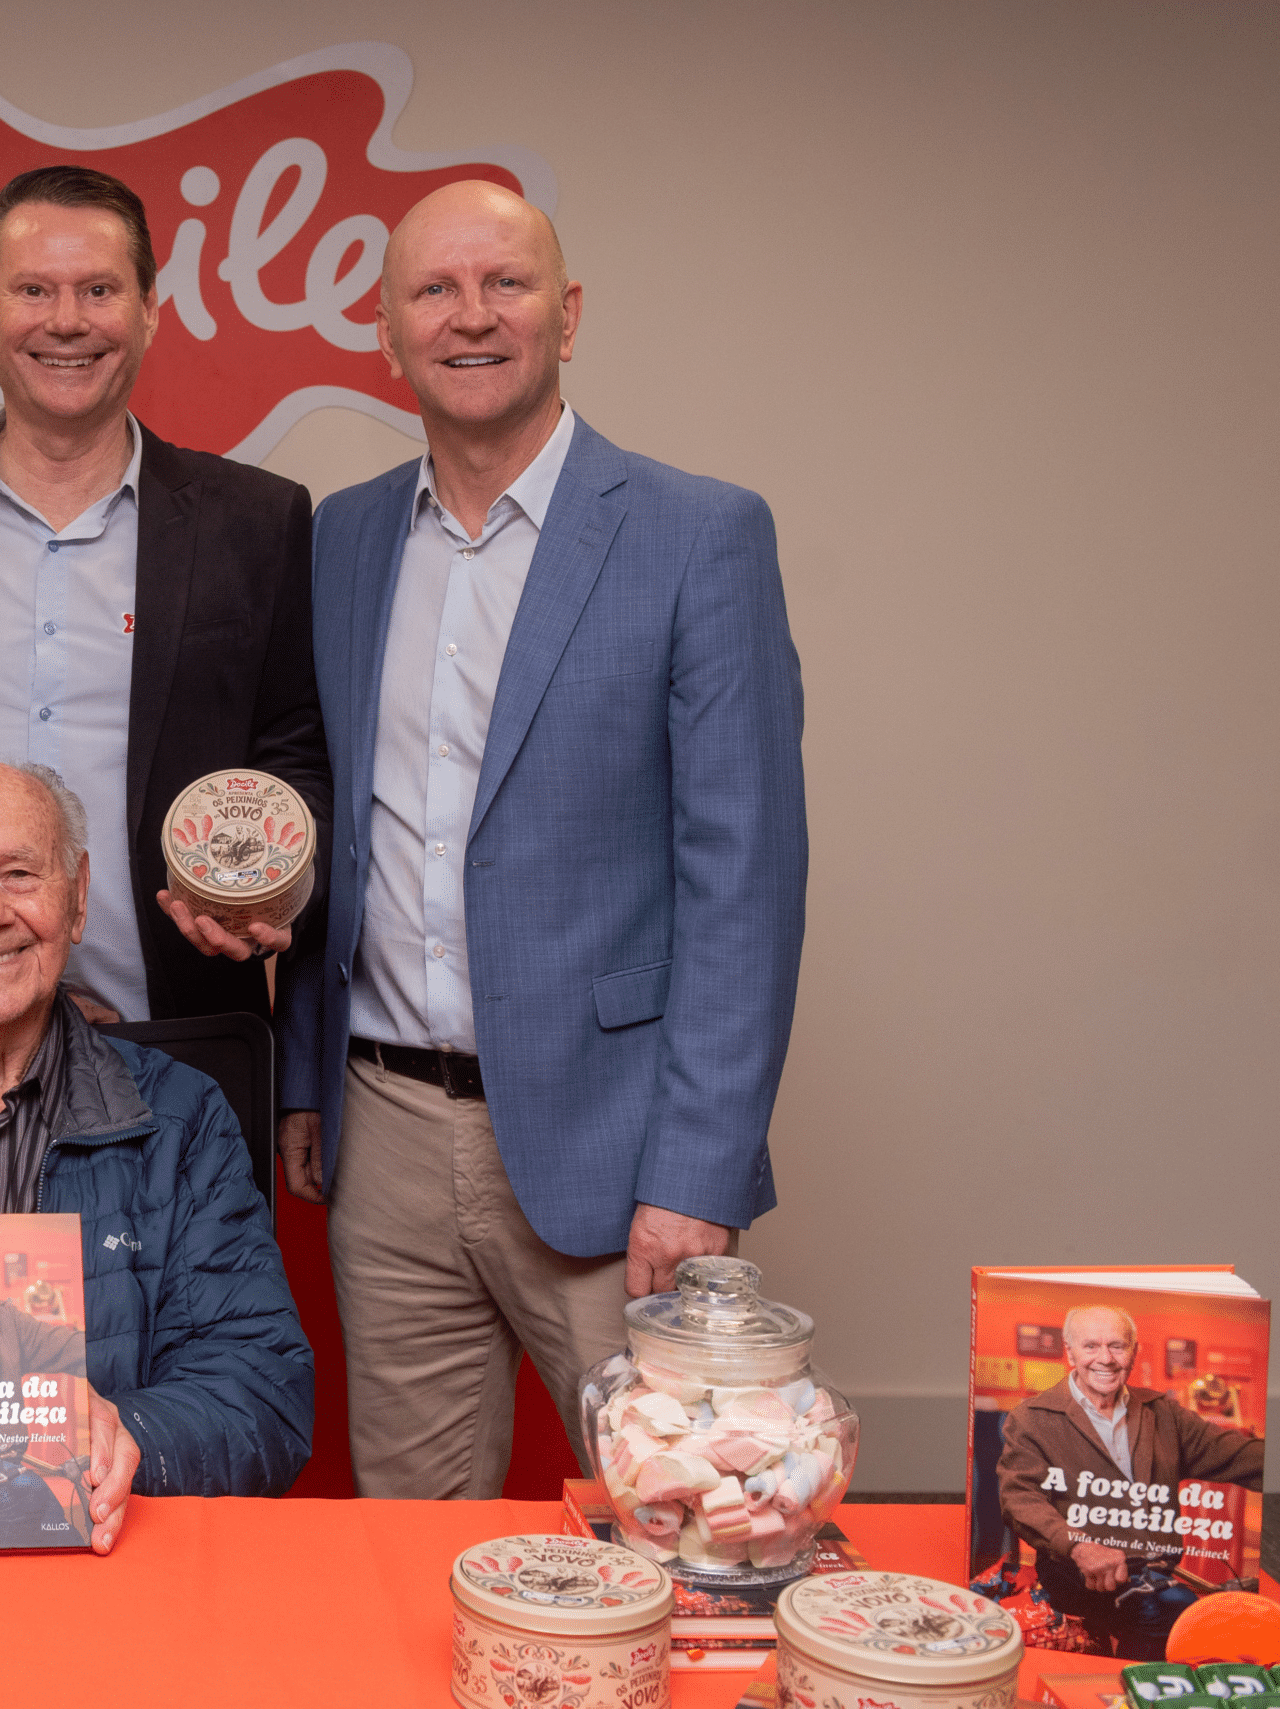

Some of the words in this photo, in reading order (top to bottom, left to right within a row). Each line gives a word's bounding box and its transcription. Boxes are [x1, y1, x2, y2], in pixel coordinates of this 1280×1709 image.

[212, 798, 223, 807] OS
[226, 796, 268, 808] PEIXINHOS
[271, 799, 289, 815] 35
[22, 1376, 58, 1399] da
[30, 1432, 67, 1444] Heineck
[1040, 1466, 1068, 1492] A
[1076, 1470, 1170, 1507] força
[1178, 1482, 1225, 1510] da
[40, 1522, 70, 1531] KALLOS
[1066, 1503, 1234, 1541] gentileza
[1067, 1531, 1092, 1544] Vida
[1094, 1537, 1101, 1545] e
[1103, 1536, 1128, 1549] obra
[1130, 1539, 1143, 1550] de
[1146, 1541, 1184, 1555] Nestor
[1185, 1545, 1231, 1561] Heineck
